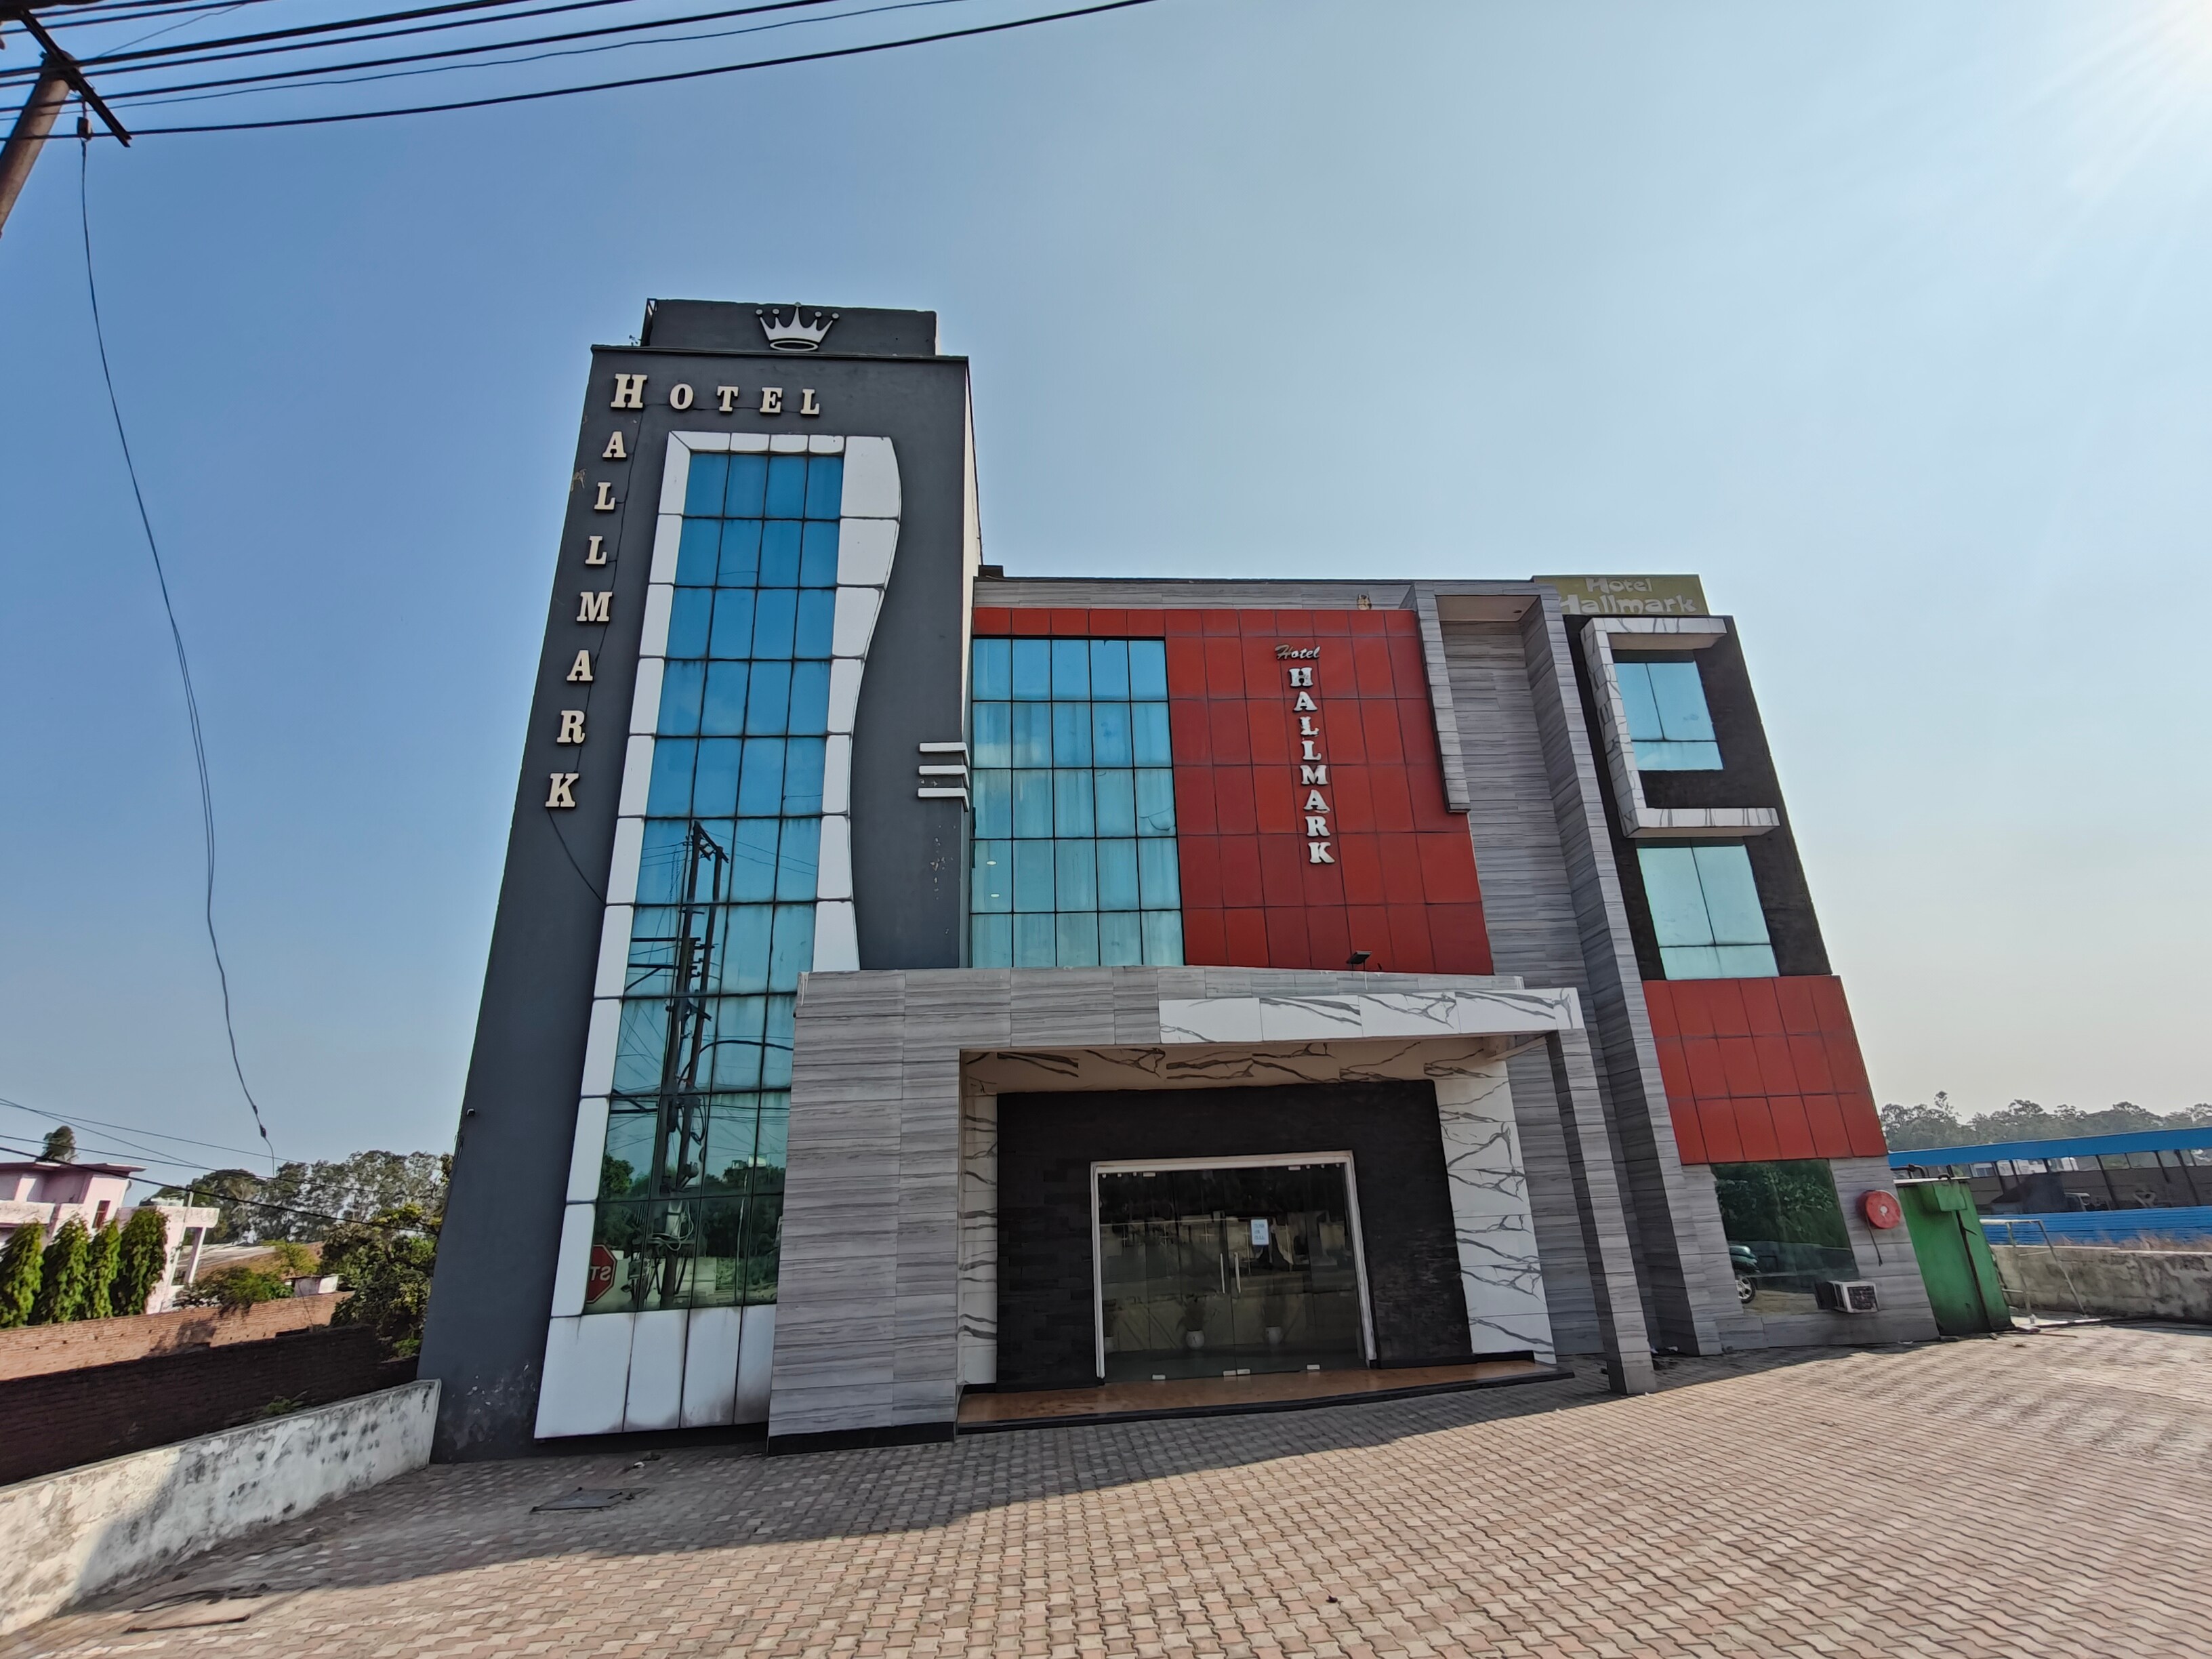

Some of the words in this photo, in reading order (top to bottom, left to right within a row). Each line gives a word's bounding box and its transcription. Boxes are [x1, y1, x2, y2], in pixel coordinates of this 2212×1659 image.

[610, 373, 821, 416] HOTEL
[1584, 577, 1654, 593] Hotel
[1559, 594, 1698, 615] Hallmark
[1275, 644, 1321, 661] Hotel
[1288, 666, 1336, 865] HALLMARK
